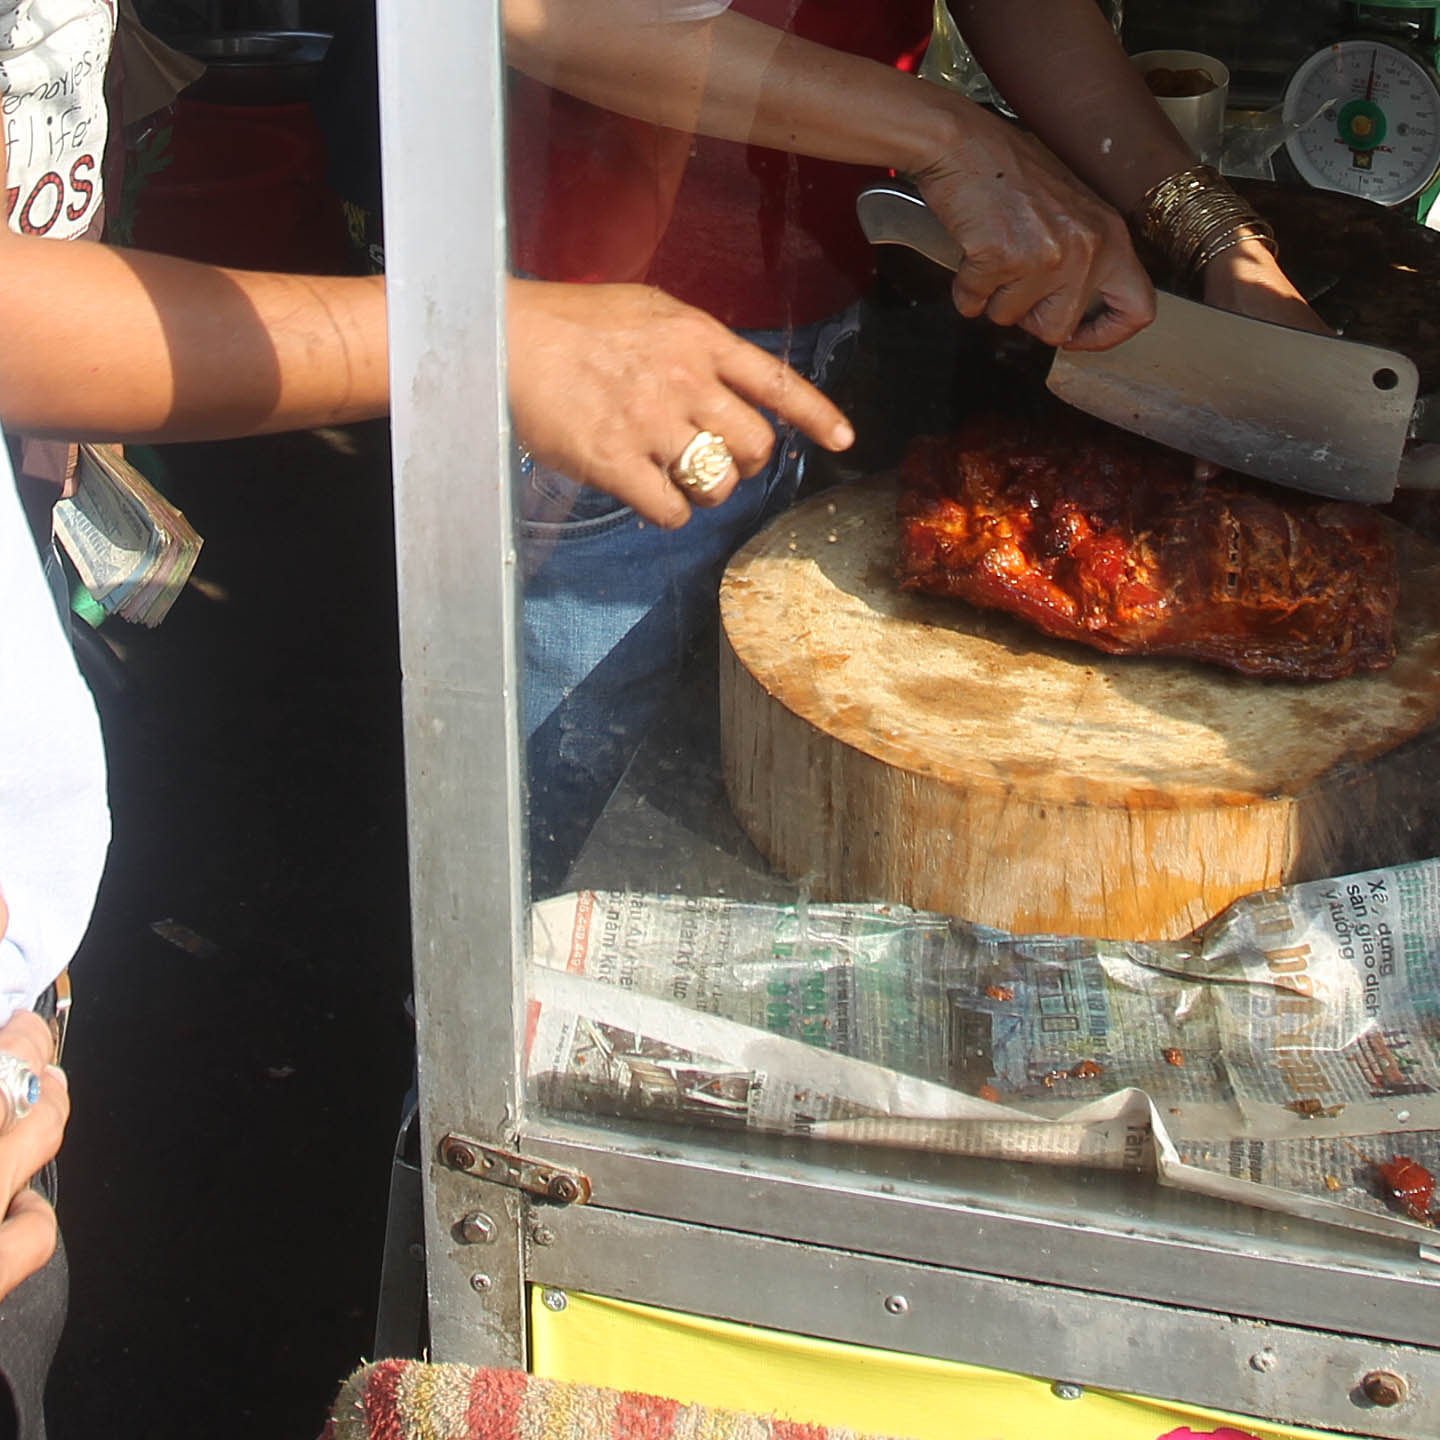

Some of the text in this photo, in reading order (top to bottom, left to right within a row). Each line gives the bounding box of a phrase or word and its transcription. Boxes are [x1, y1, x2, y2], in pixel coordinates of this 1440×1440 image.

[1345, 882, 1381, 1019] sàn giao dịch
[1376, 921, 1397, 976] dựng
